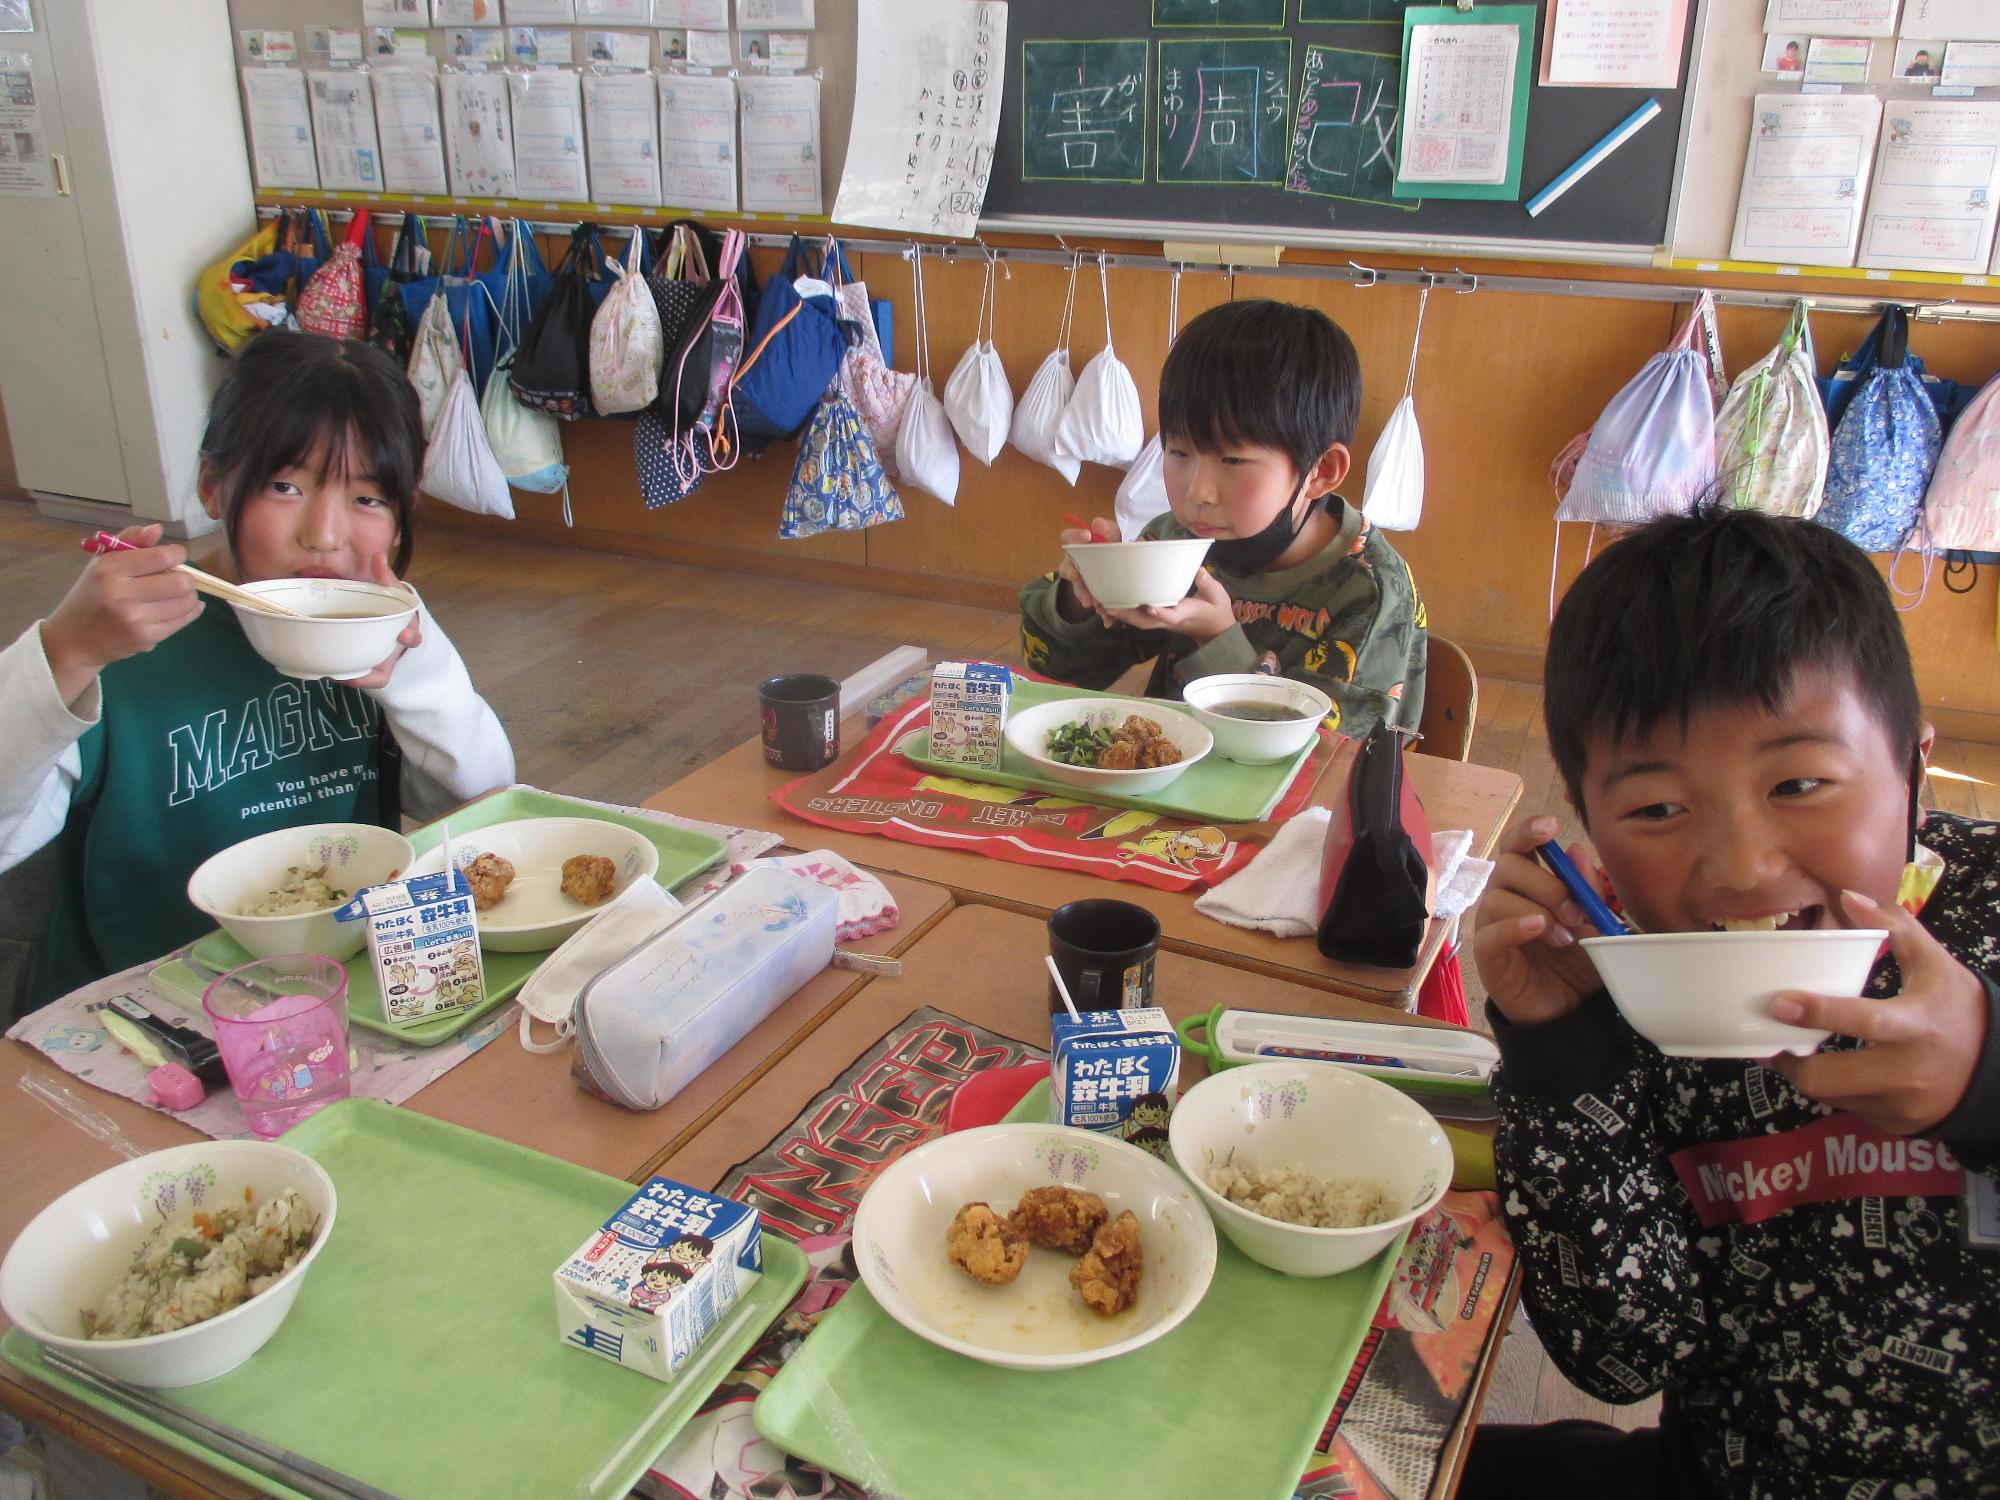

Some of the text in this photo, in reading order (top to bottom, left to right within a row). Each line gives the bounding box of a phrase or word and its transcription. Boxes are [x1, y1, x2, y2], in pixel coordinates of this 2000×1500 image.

[976, 32, 989, 45] 20
[1163, 65, 1184, 140] まわり
[1264, 70, 1290, 124] シュウ
[1046, 66, 1115, 169] 害
[1181, 67, 1260, 178] 周
[966, 682, 1001, 695] 森牛乳
[276, 779, 306, 794] You
[310, 766, 349, 787] have
[241, 792, 313, 819] potential
[317, 782, 354, 800] than
[420, 899, 471, 923] 森牛乳
[397, 929, 415, 939] 牛乳
[1074, 1055, 1150, 1077] わたぼく
[1072, 1075, 1150, 1102] 森牛乳
[1098, 1102, 1119, 1112] 牛乳
[1580, 1098, 1620, 1131] MICKEY
[732, 1020, 1010, 1240] INGER
[628, 1196, 712, 1236] 森牛乳
[648, 1182, 723, 1218] わたぼく
